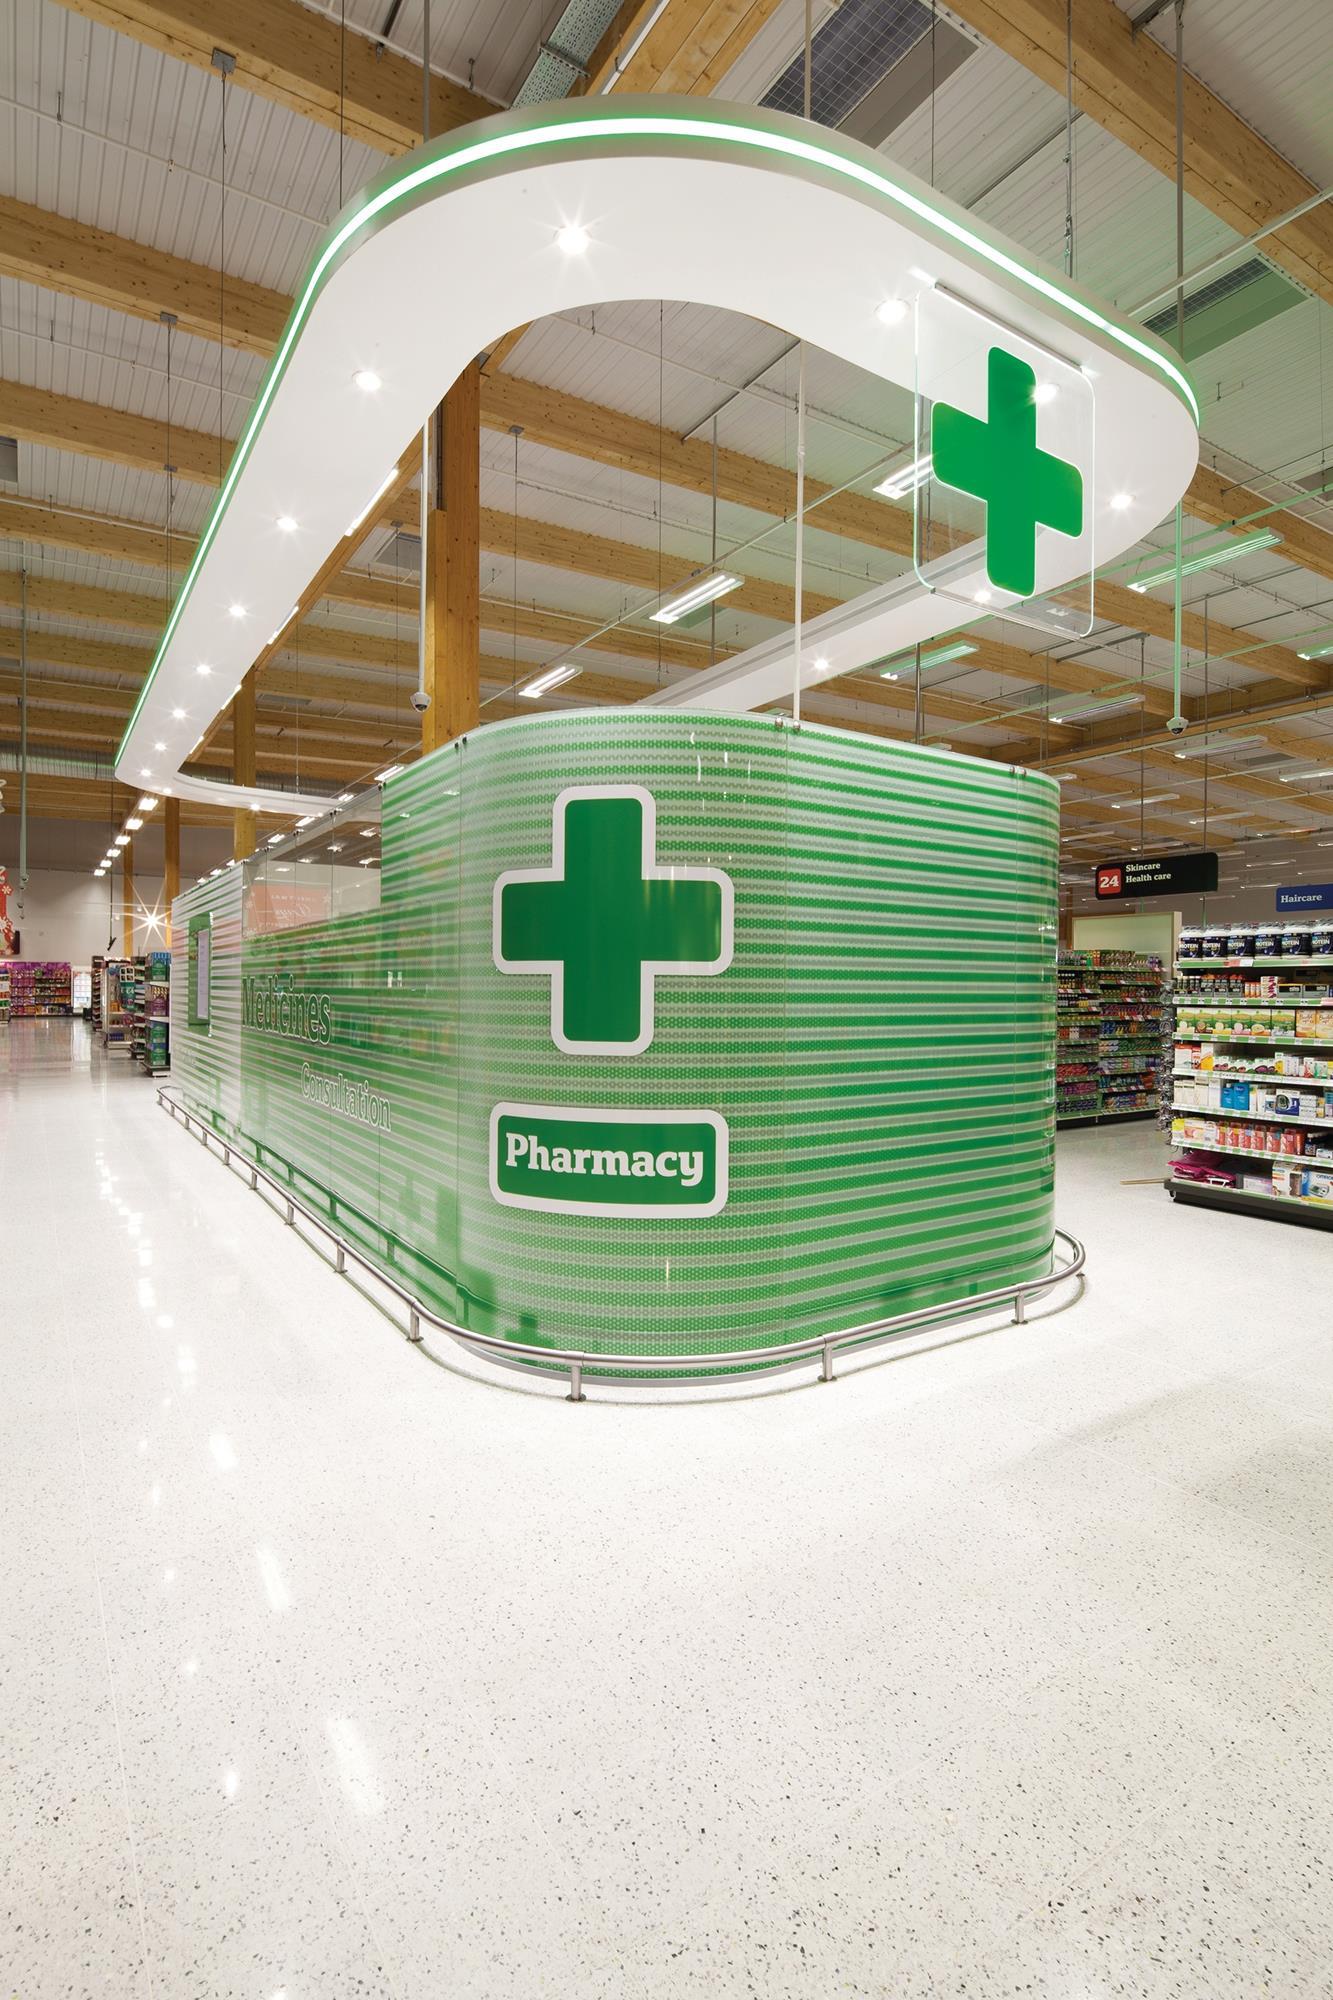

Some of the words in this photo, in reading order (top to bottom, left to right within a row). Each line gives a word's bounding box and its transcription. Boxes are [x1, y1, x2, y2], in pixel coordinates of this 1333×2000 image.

[1125, 863, 1161, 872] Skincare
[1099, 875, 1119, 888] 24
[1125, 874, 1152, 883] Health
[1154, 873, 1172, 881] care
[1280, 894, 1323, 903] Haircare
[242, 974, 333, 1045] Medicines
[301, 1062, 392, 1132] Consultation
[505, 1132, 704, 1187] Pharmacy
